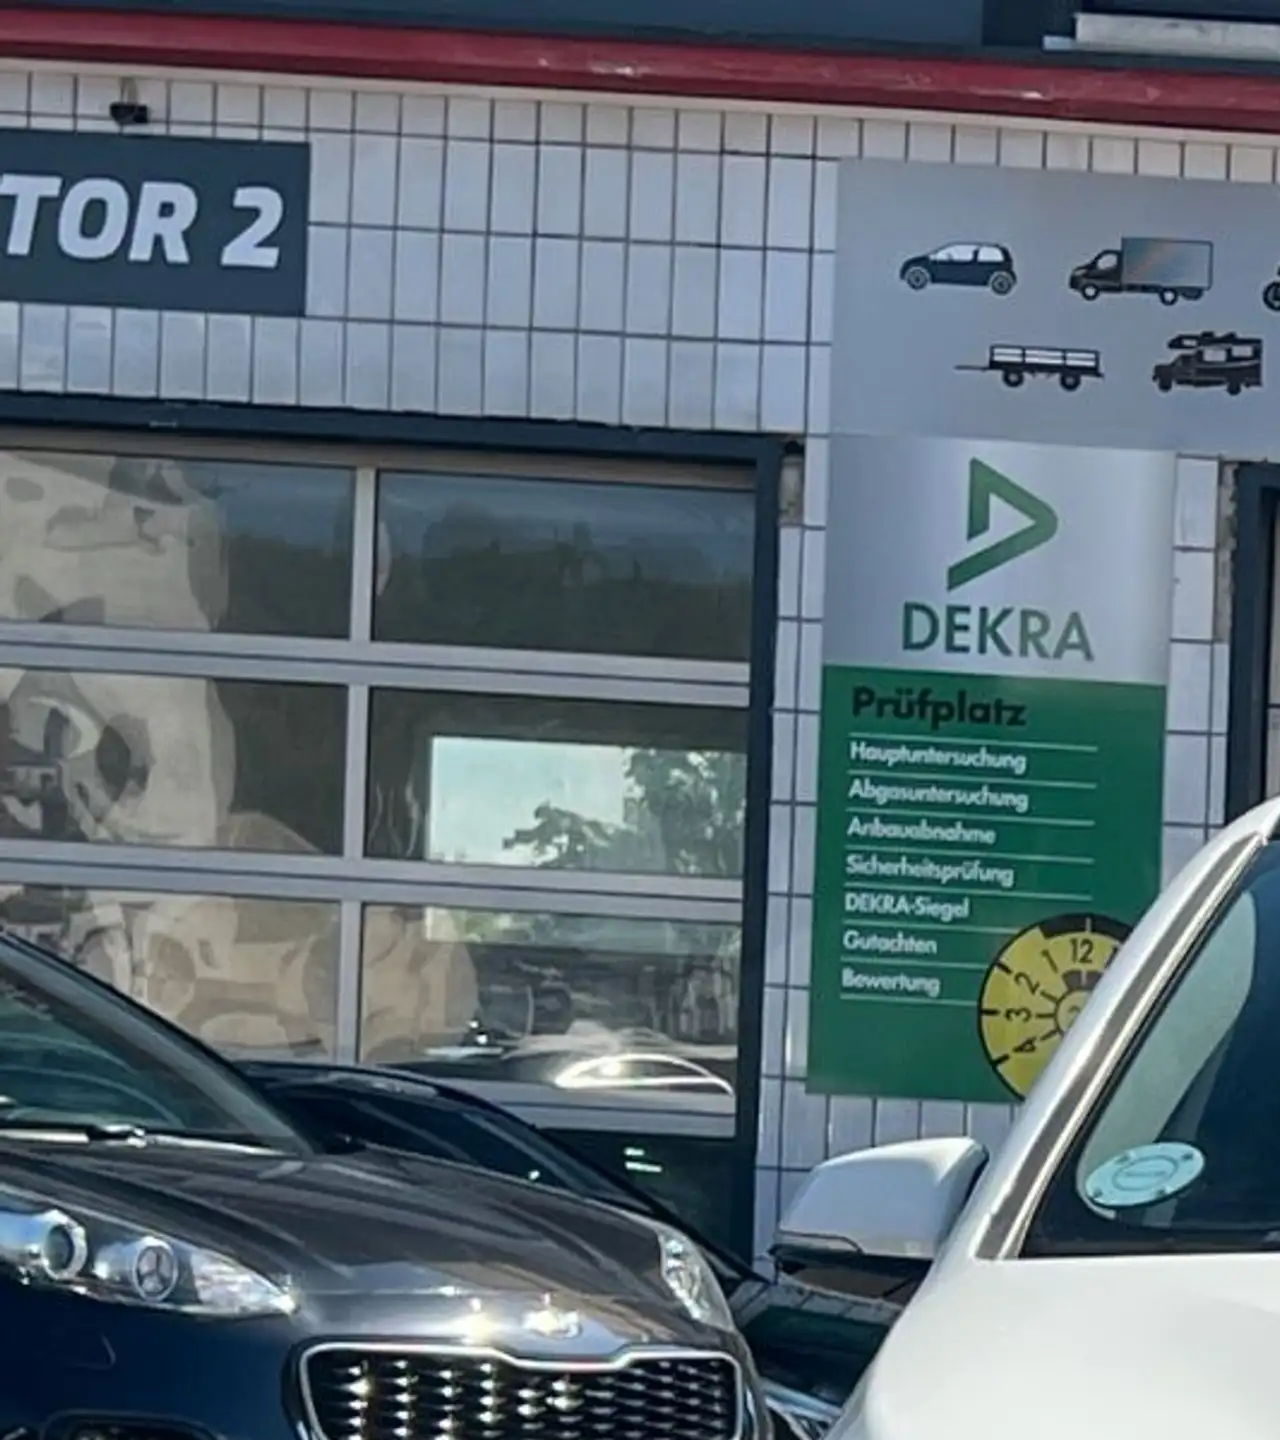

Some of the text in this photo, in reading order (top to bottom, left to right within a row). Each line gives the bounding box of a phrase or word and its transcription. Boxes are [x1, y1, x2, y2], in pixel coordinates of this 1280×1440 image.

[1, 174, 284, 269] TOR 2
[903, 601, 1094, 662] DEKRA
[852, 686, 1026, 730] Prüfplatz
[851, 741, 1026, 774] Hauptuntersuchung
[849, 778, 1028, 813] Abgasuntersuchung
[847, 816, 996, 844] Anbauabnahme
[846, 854, 1014, 888] Sicherheitsprüfung
[845, 892, 969, 922] DEKRA-Siegel
[843, 929, 937, 954] Gutachten
[1070, 938, 1094, 963] 12
[1041, 949, 1058, 973] 1
[842, 967, 940, 997] Bewertung
[1014, 971, 1040, 995] 2
[1005, 1008, 1032, 1022] 3
[1012, 1037, 1037, 1053] 4
